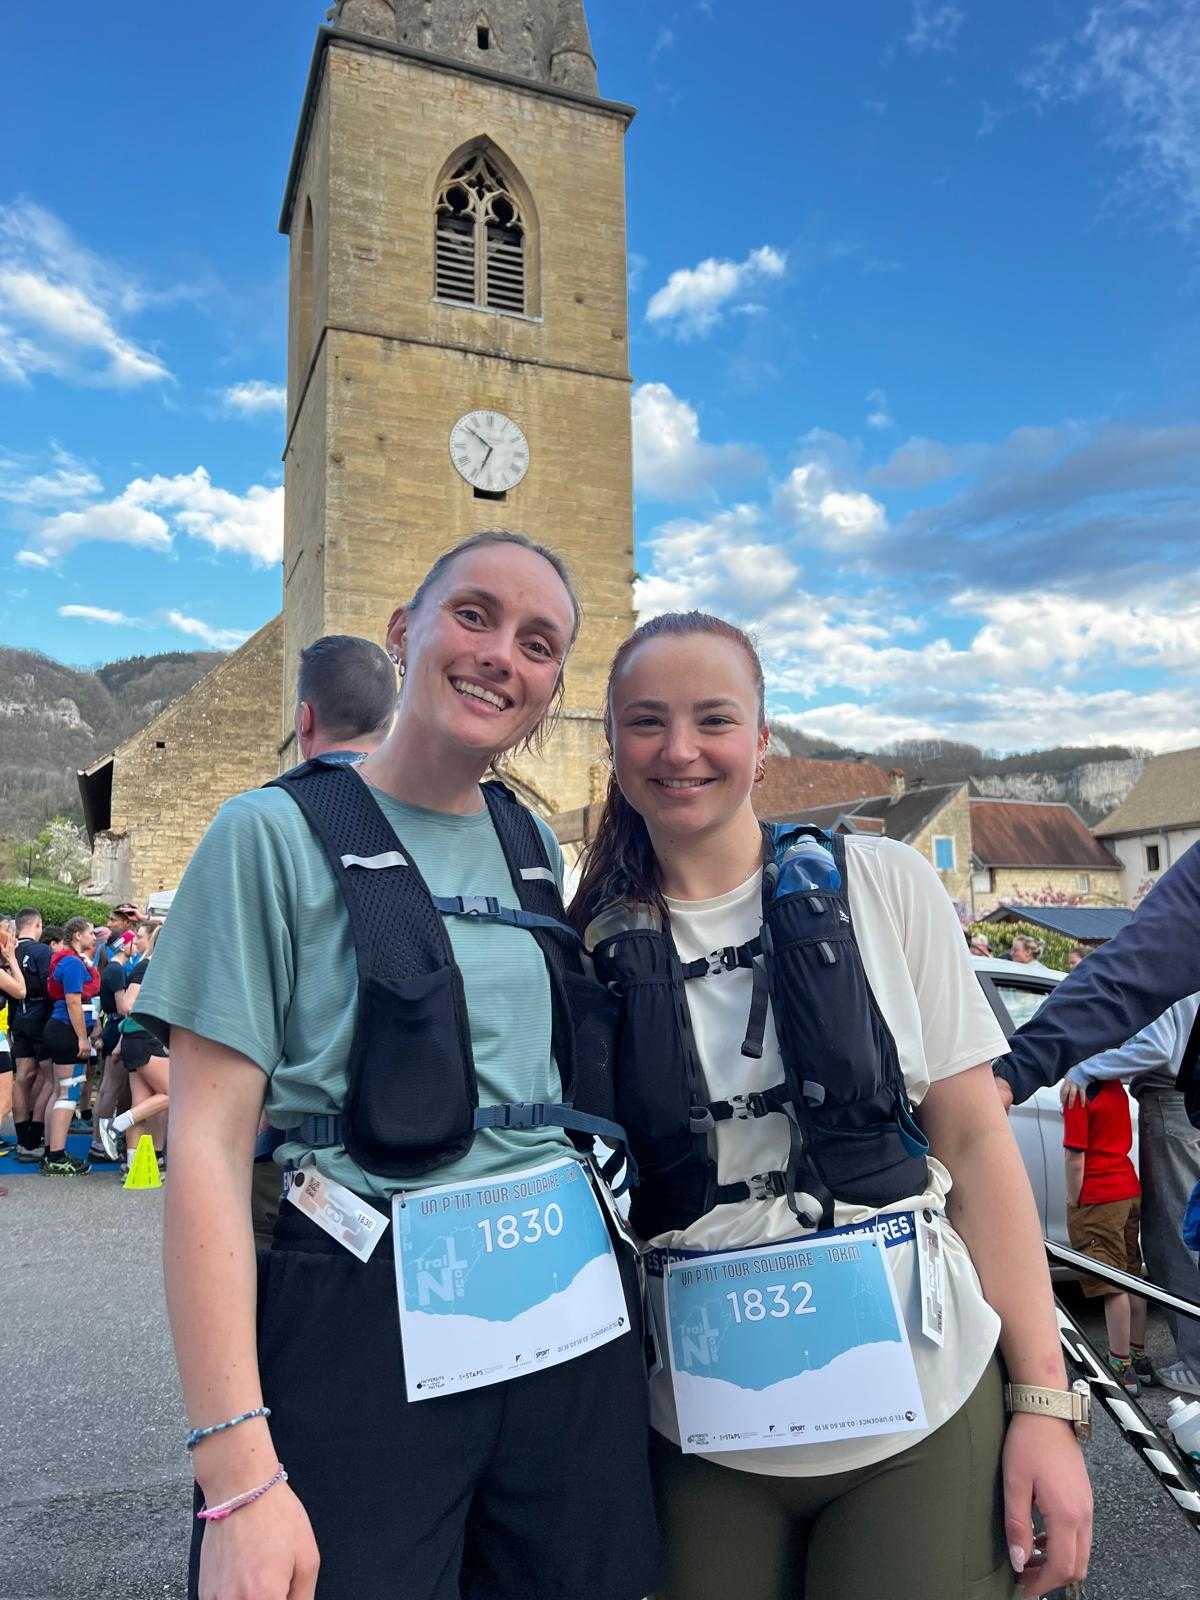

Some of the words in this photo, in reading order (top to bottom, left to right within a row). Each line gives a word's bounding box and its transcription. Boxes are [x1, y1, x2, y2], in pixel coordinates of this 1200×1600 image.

[421, 1199, 437, 1215] UN
[477, 1187, 509, 1206] TOUR
[513, 1173, 560, 1199] SOLIDAIRE
[476, 1202, 564, 1254] 1830
[681, 1269, 693, 1287] UN
[722, 1262, 749, 1281] TOUR
[753, 1251, 814, 1275] SOLIDAIRE
[828, 1246, 861, 1264] 10KM
[726, 1281, 817, 1325] 1832
